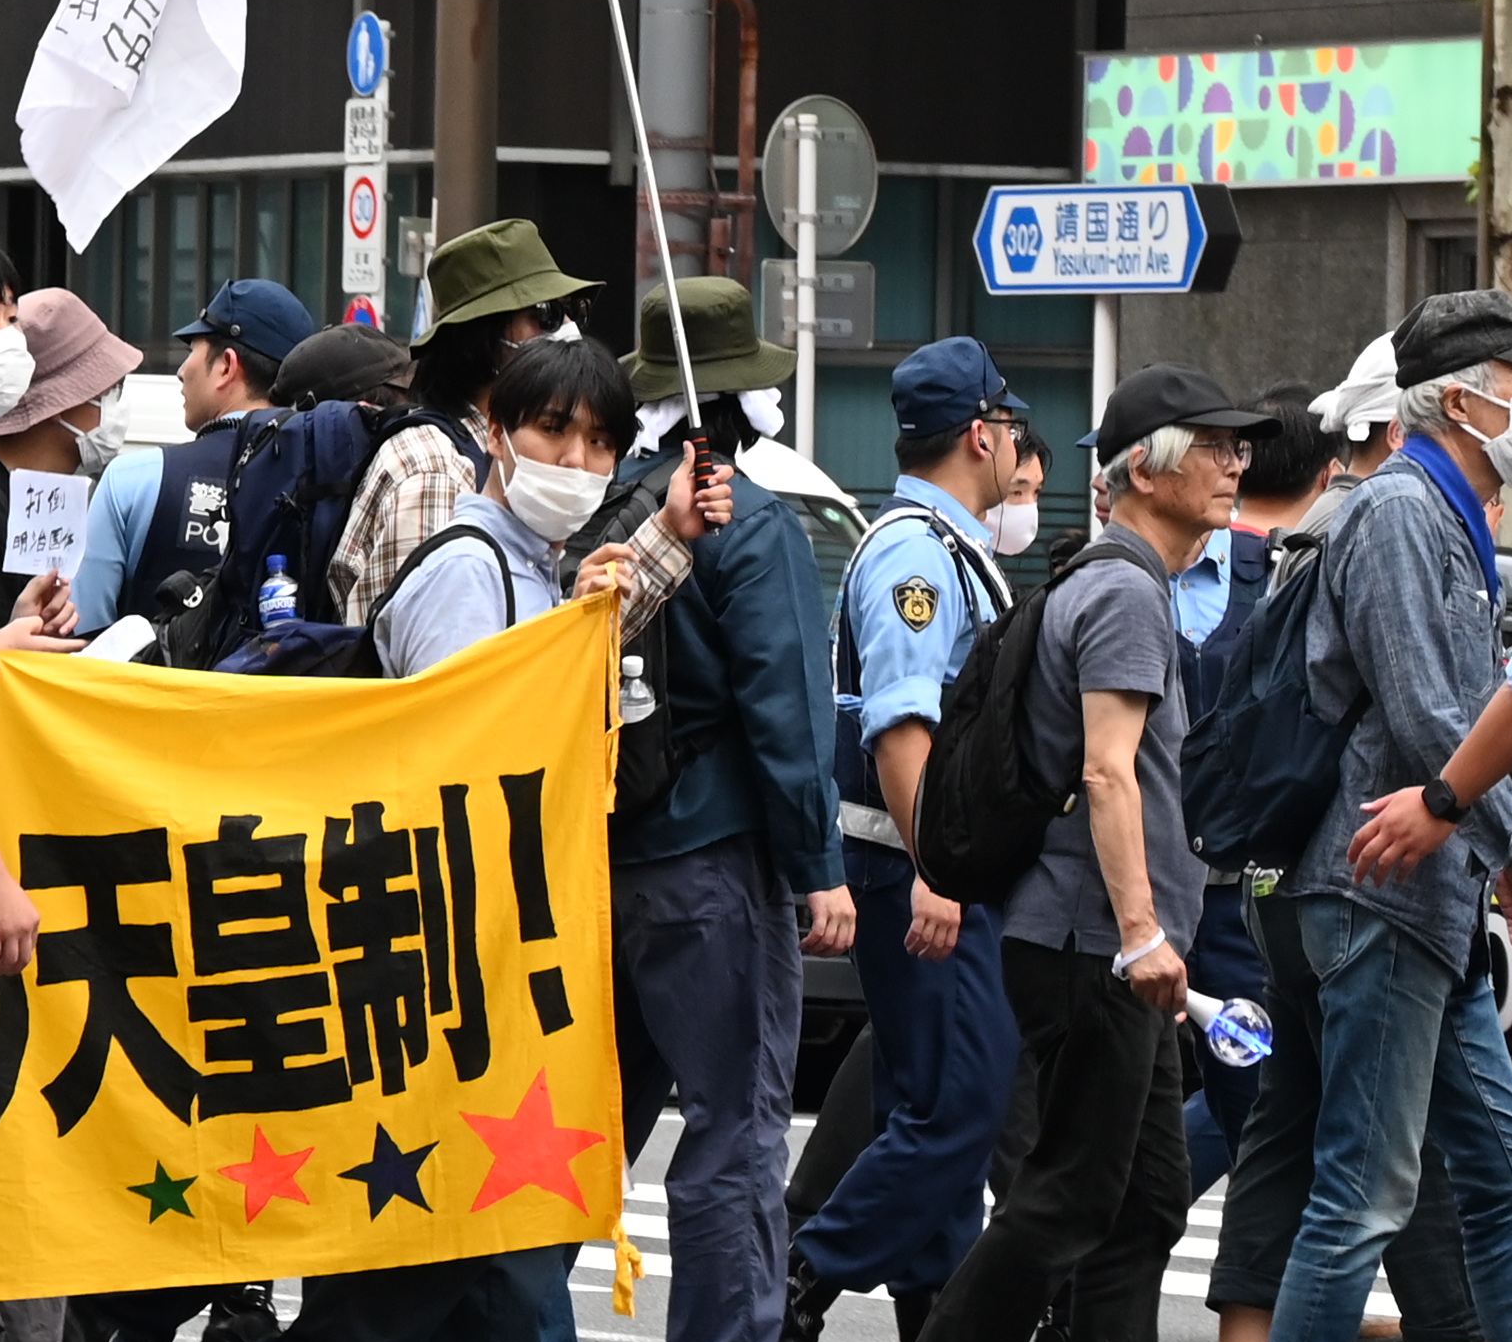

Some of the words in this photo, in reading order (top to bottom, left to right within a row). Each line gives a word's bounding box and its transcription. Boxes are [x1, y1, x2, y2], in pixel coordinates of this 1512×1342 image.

[1055, 200, 1170, 243] 靖国通り
[1005, 224, 1039, 257] 302
[1053, 247, 1142, 277] Yasukuni-dori
[1144, 247, 1172, 275] Ave.
[24, 483, 67, 520] 打倒
